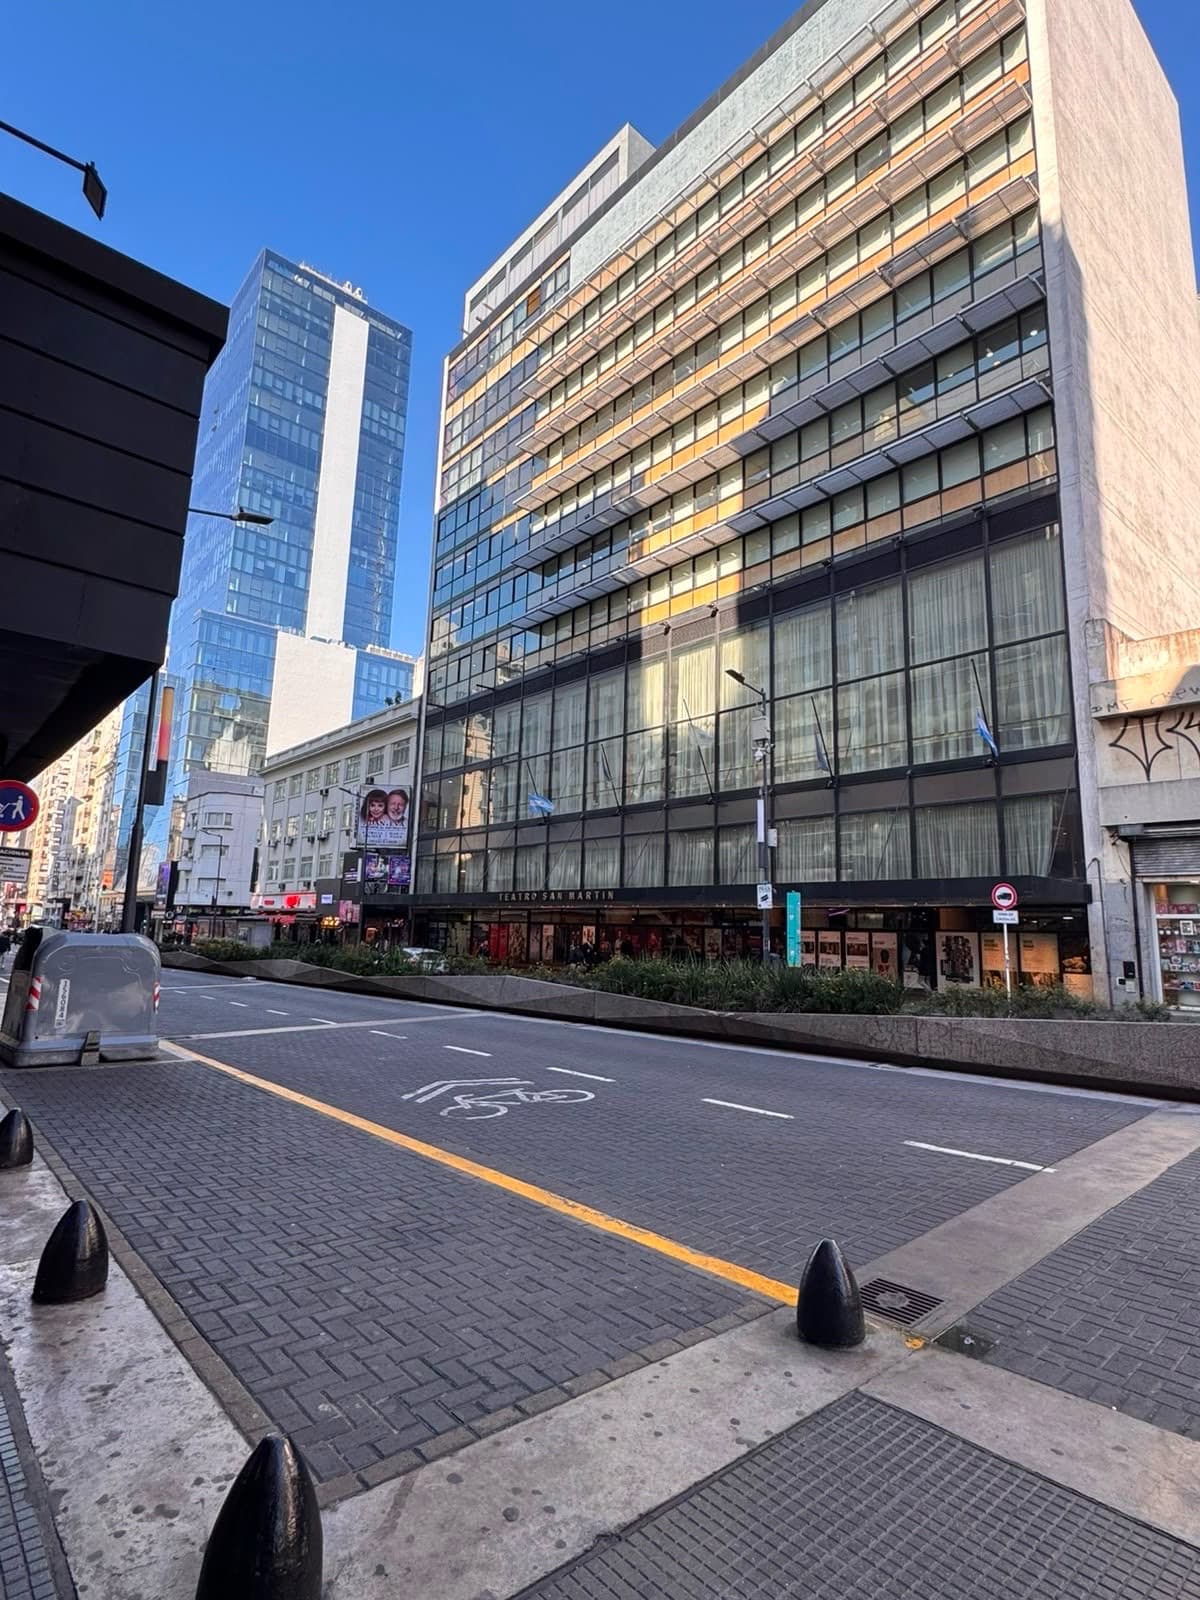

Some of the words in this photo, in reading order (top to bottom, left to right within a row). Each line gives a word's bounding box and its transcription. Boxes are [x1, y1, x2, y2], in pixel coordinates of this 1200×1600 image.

[498, 892, 537, 902] TEATRO
[542, 891, 562, 901] SAN
[568, 890, 615, 901] MARTIN
